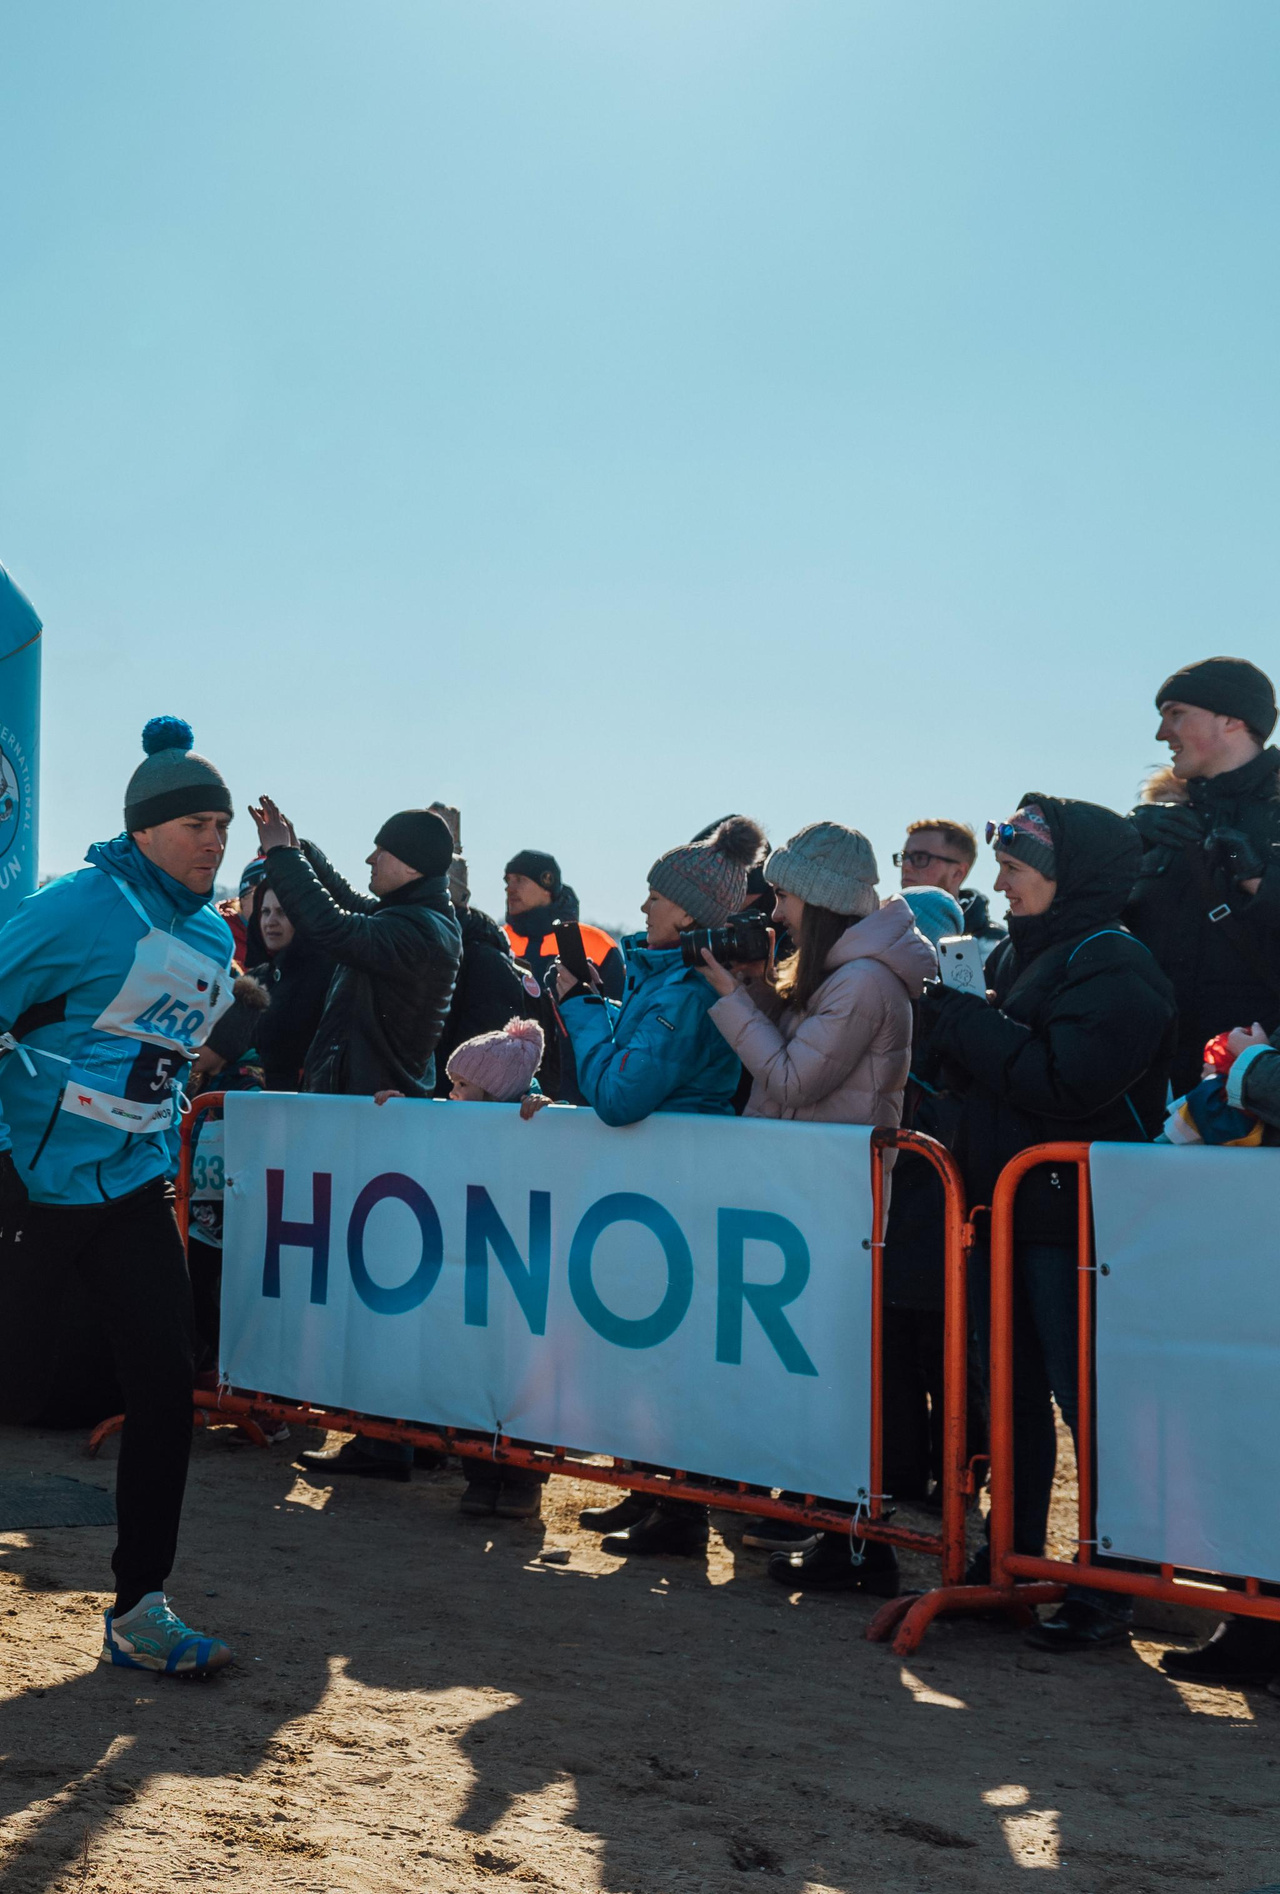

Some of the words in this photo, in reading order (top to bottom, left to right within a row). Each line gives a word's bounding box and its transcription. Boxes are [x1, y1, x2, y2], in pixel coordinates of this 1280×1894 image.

[133, 992, 206, 1047] 458
[149, 1058, 172, 1092] 5
[261, 1168, 819, 1376] HONOR
